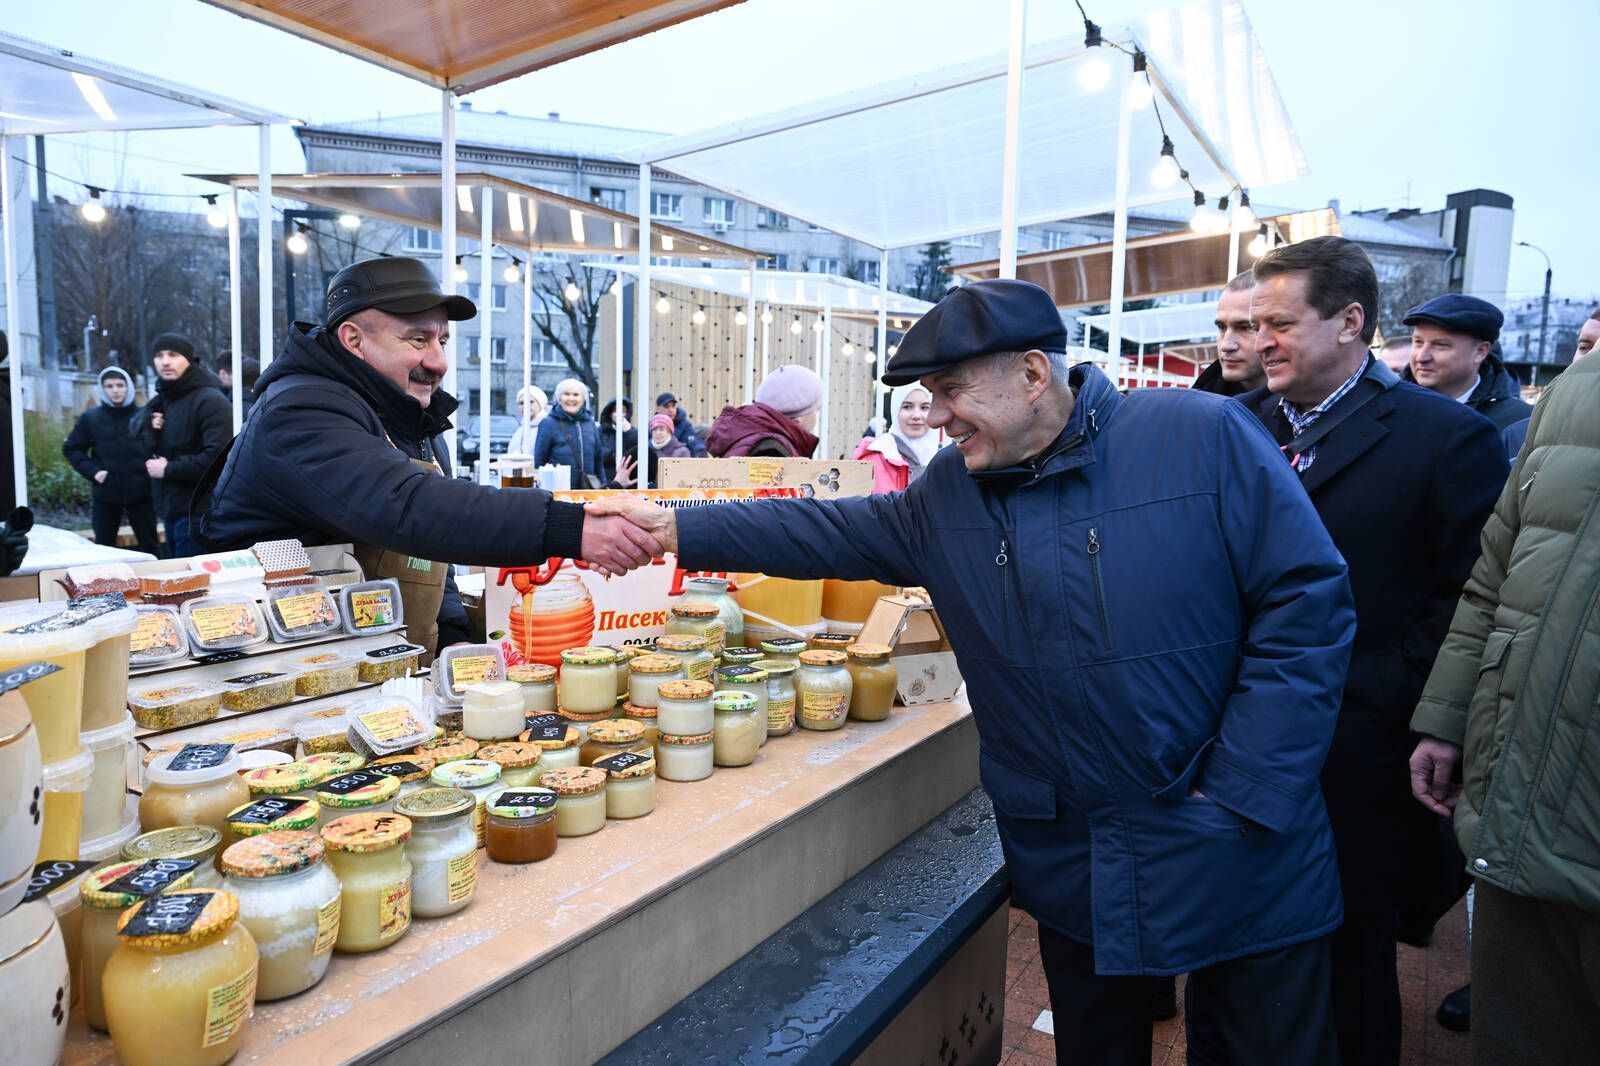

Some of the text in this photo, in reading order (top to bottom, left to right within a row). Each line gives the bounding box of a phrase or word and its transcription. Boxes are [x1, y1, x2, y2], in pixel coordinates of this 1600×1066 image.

[598, 608, 668, 631] Пасек
[0, 664, 44, 692] 00
[527, 714, 556, 726] 450
[612, 754, 637, 768] 250
[329, 774, 368, 790] 550
[512, 795, 552, 804] 250
[256, 799, 285, 820] 550
[130, 862, 178, 888] 550
